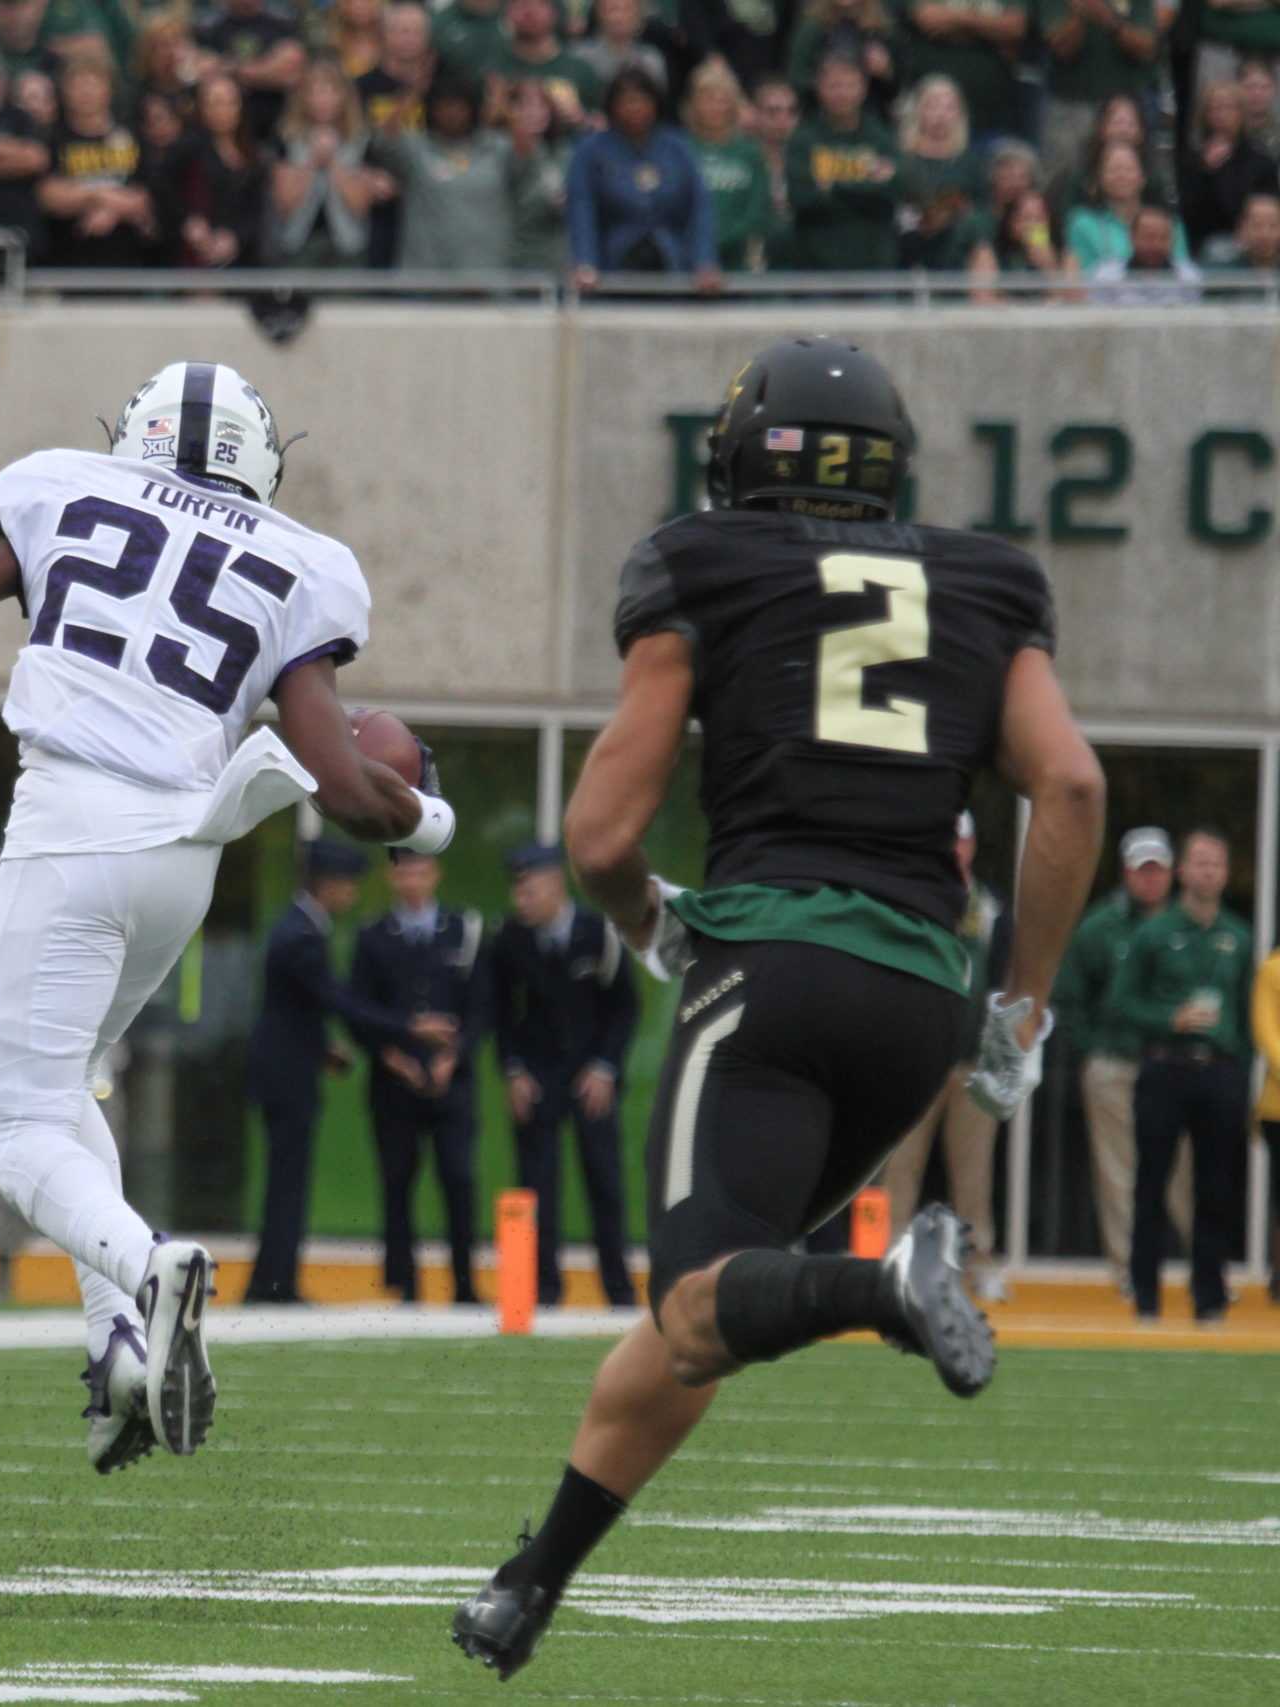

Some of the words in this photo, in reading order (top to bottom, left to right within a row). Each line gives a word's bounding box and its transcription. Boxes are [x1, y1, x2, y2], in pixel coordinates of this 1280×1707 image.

[214, 442, 239, 465] 25
[817, 433, 851, 486] 2
[141, 479, 261, 535] TURPIN
[972, 422, 1133, 544] 12
[1188, 428, 1275, 549] C
[30, 495, 298, 715] 25
[815, 553, 929, 754] 2
[681, 970, 744, 1024] BAYLOR
